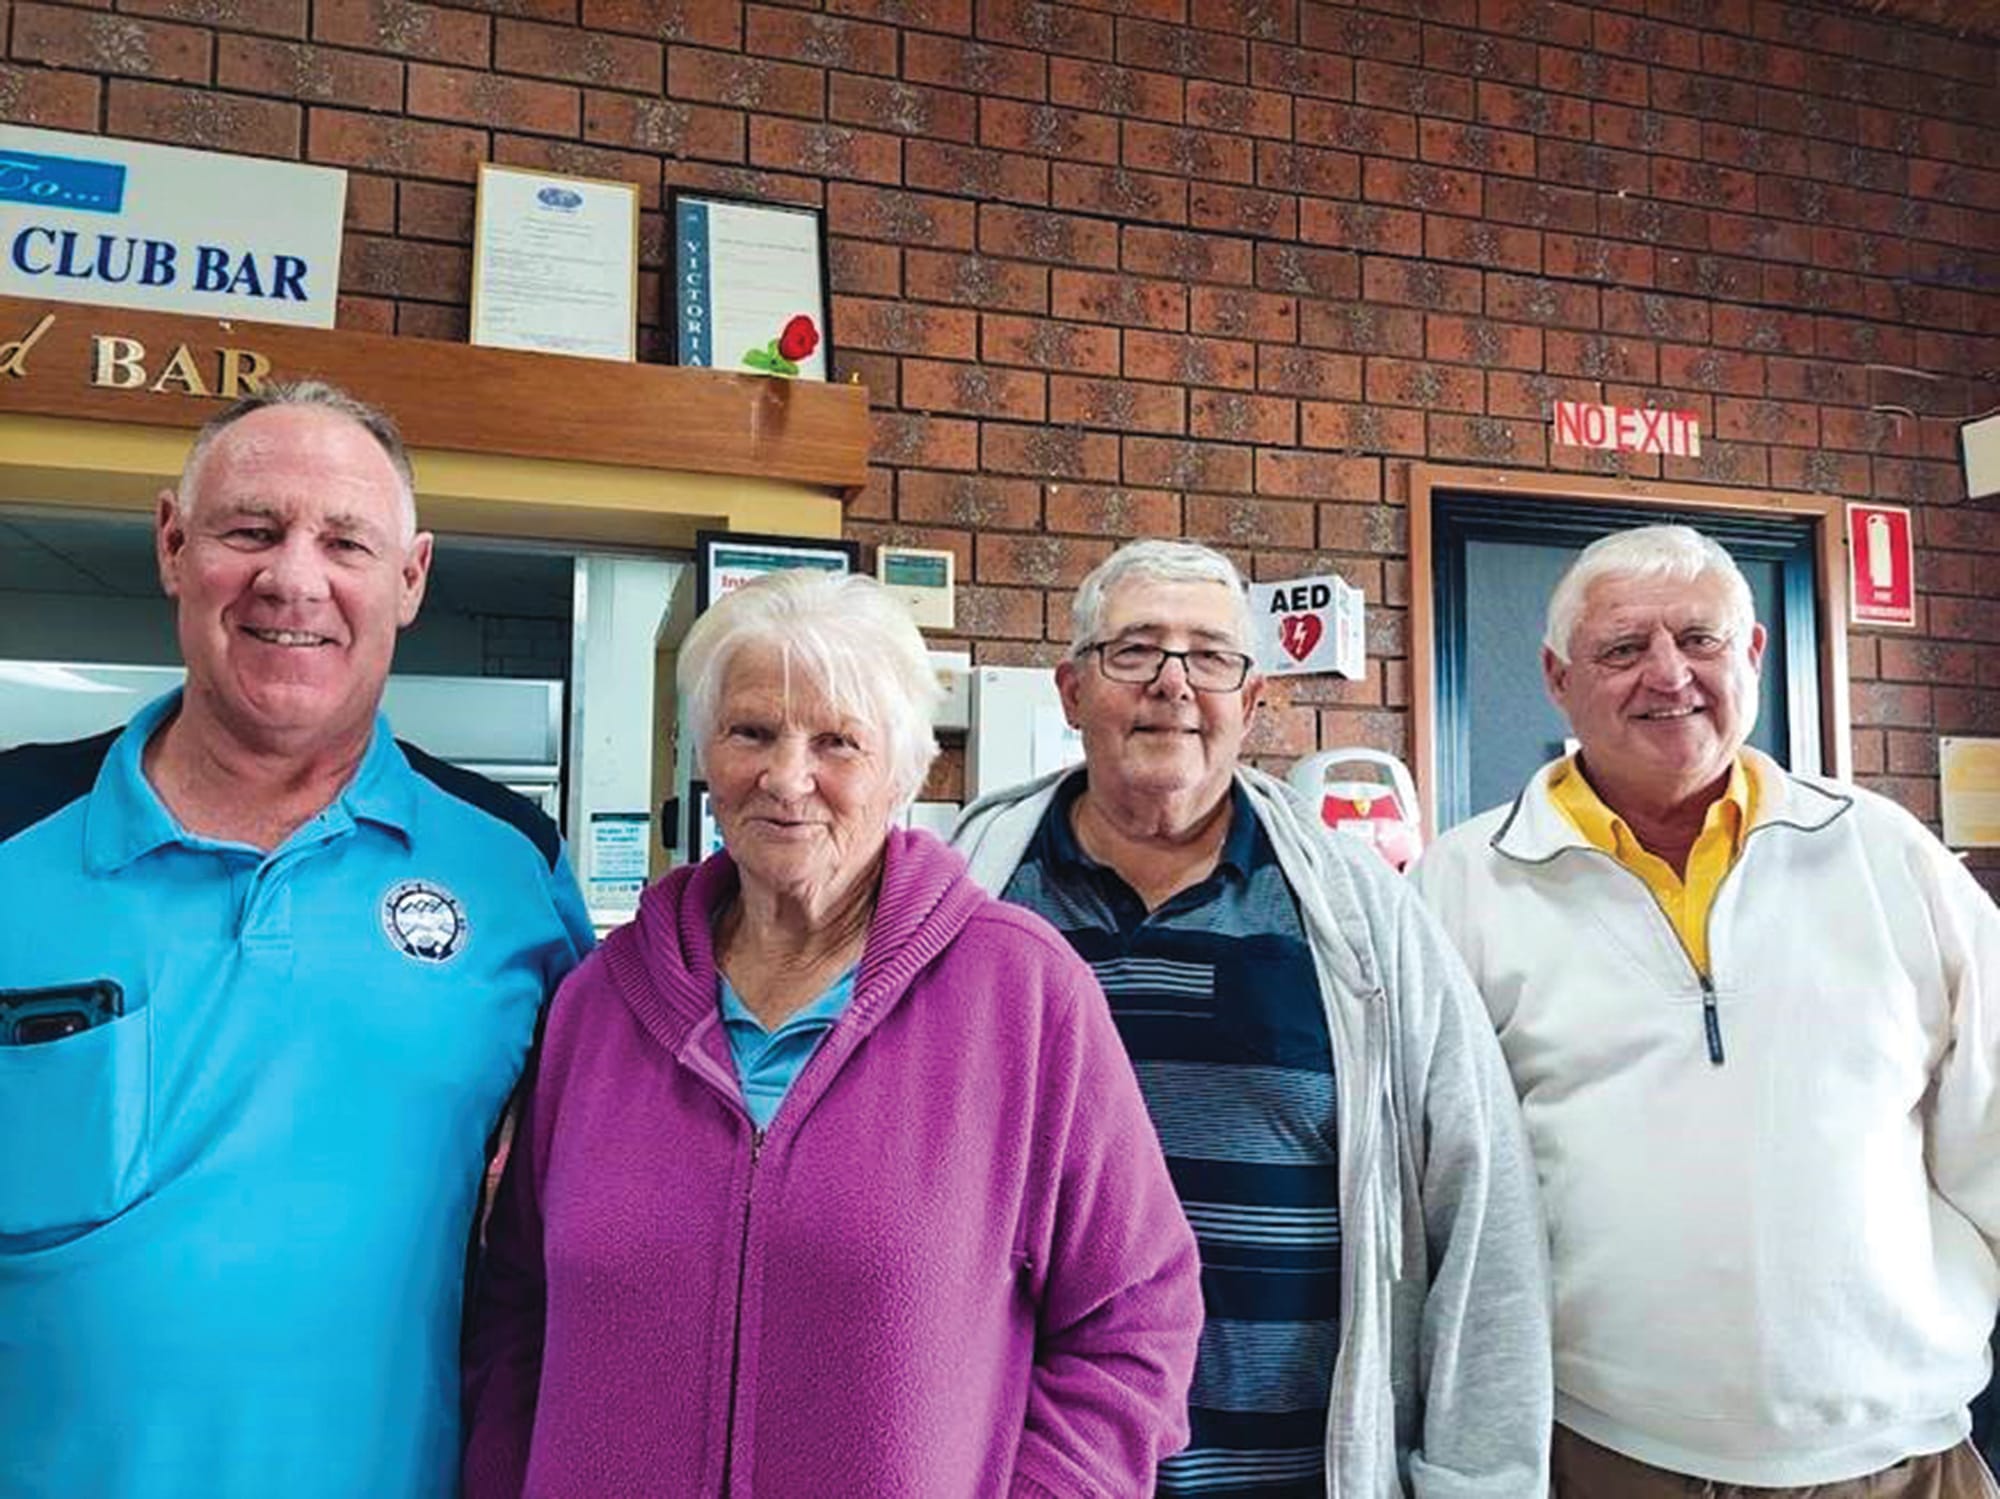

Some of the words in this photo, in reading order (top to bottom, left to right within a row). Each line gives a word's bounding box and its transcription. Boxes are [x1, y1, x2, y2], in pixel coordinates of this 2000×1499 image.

[12, 226, 177, 287] CLUB
[194, 245, 309, 301] BAR
[685, 240, 704, 366] VICTORIA
[91, 334, 272, 399] BAR
[1556, 401, 1607, 447] NO
[1615, 404, 1700, 457] EXIT
[1270, 584, 1331, 614] AED
